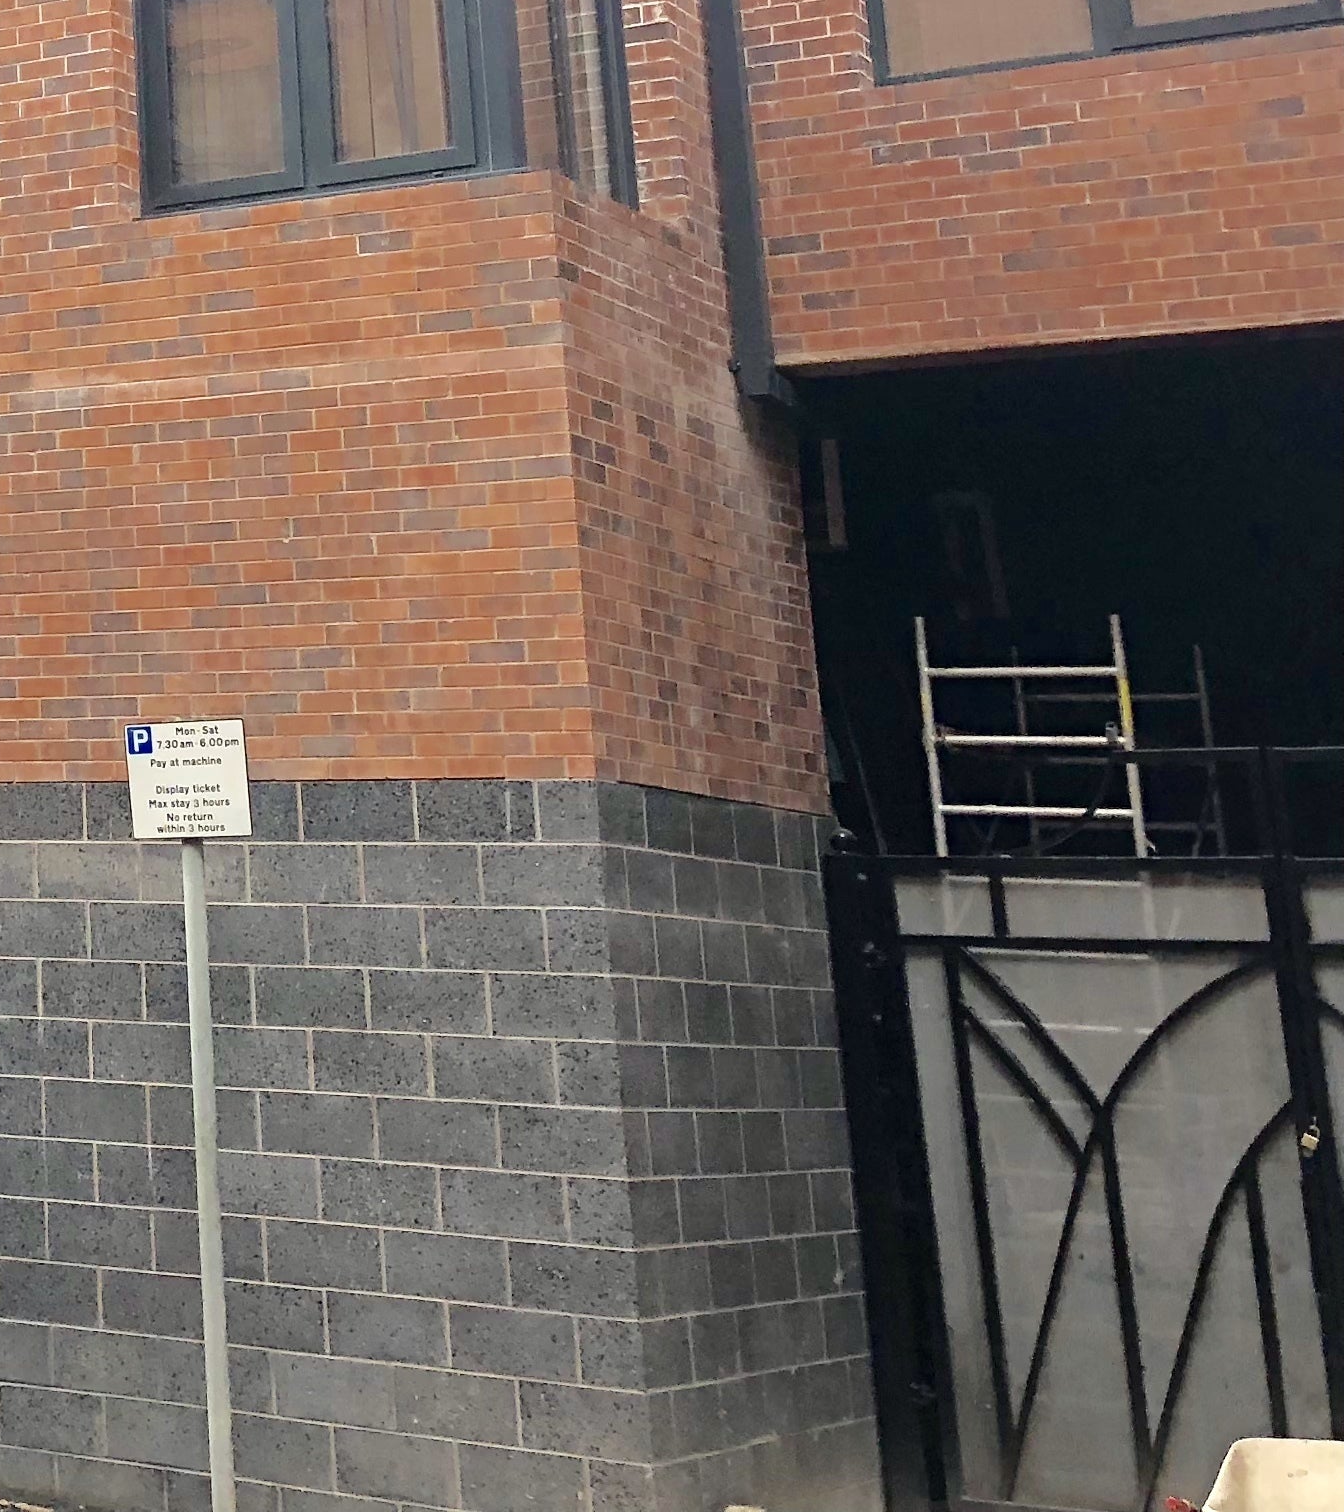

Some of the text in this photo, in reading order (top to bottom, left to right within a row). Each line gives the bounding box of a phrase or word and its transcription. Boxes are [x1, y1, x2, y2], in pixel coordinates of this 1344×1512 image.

[175, 727, 196, 735] Mon
[202, 725, 219, 734] Sat
[133, 729, 149, 752] P
[150, 756, 222, 768] Pay at machine
[155, 783, 221, 795] Display ticket
[148, 799, 168, 809] Max
[170, 799, 191, 809] stay
[202, 797, 231, 807] hours
[166, 813, 214, 822] No return
[157, 825, 186, 834] within
[197, 823, 226, 832] hours
